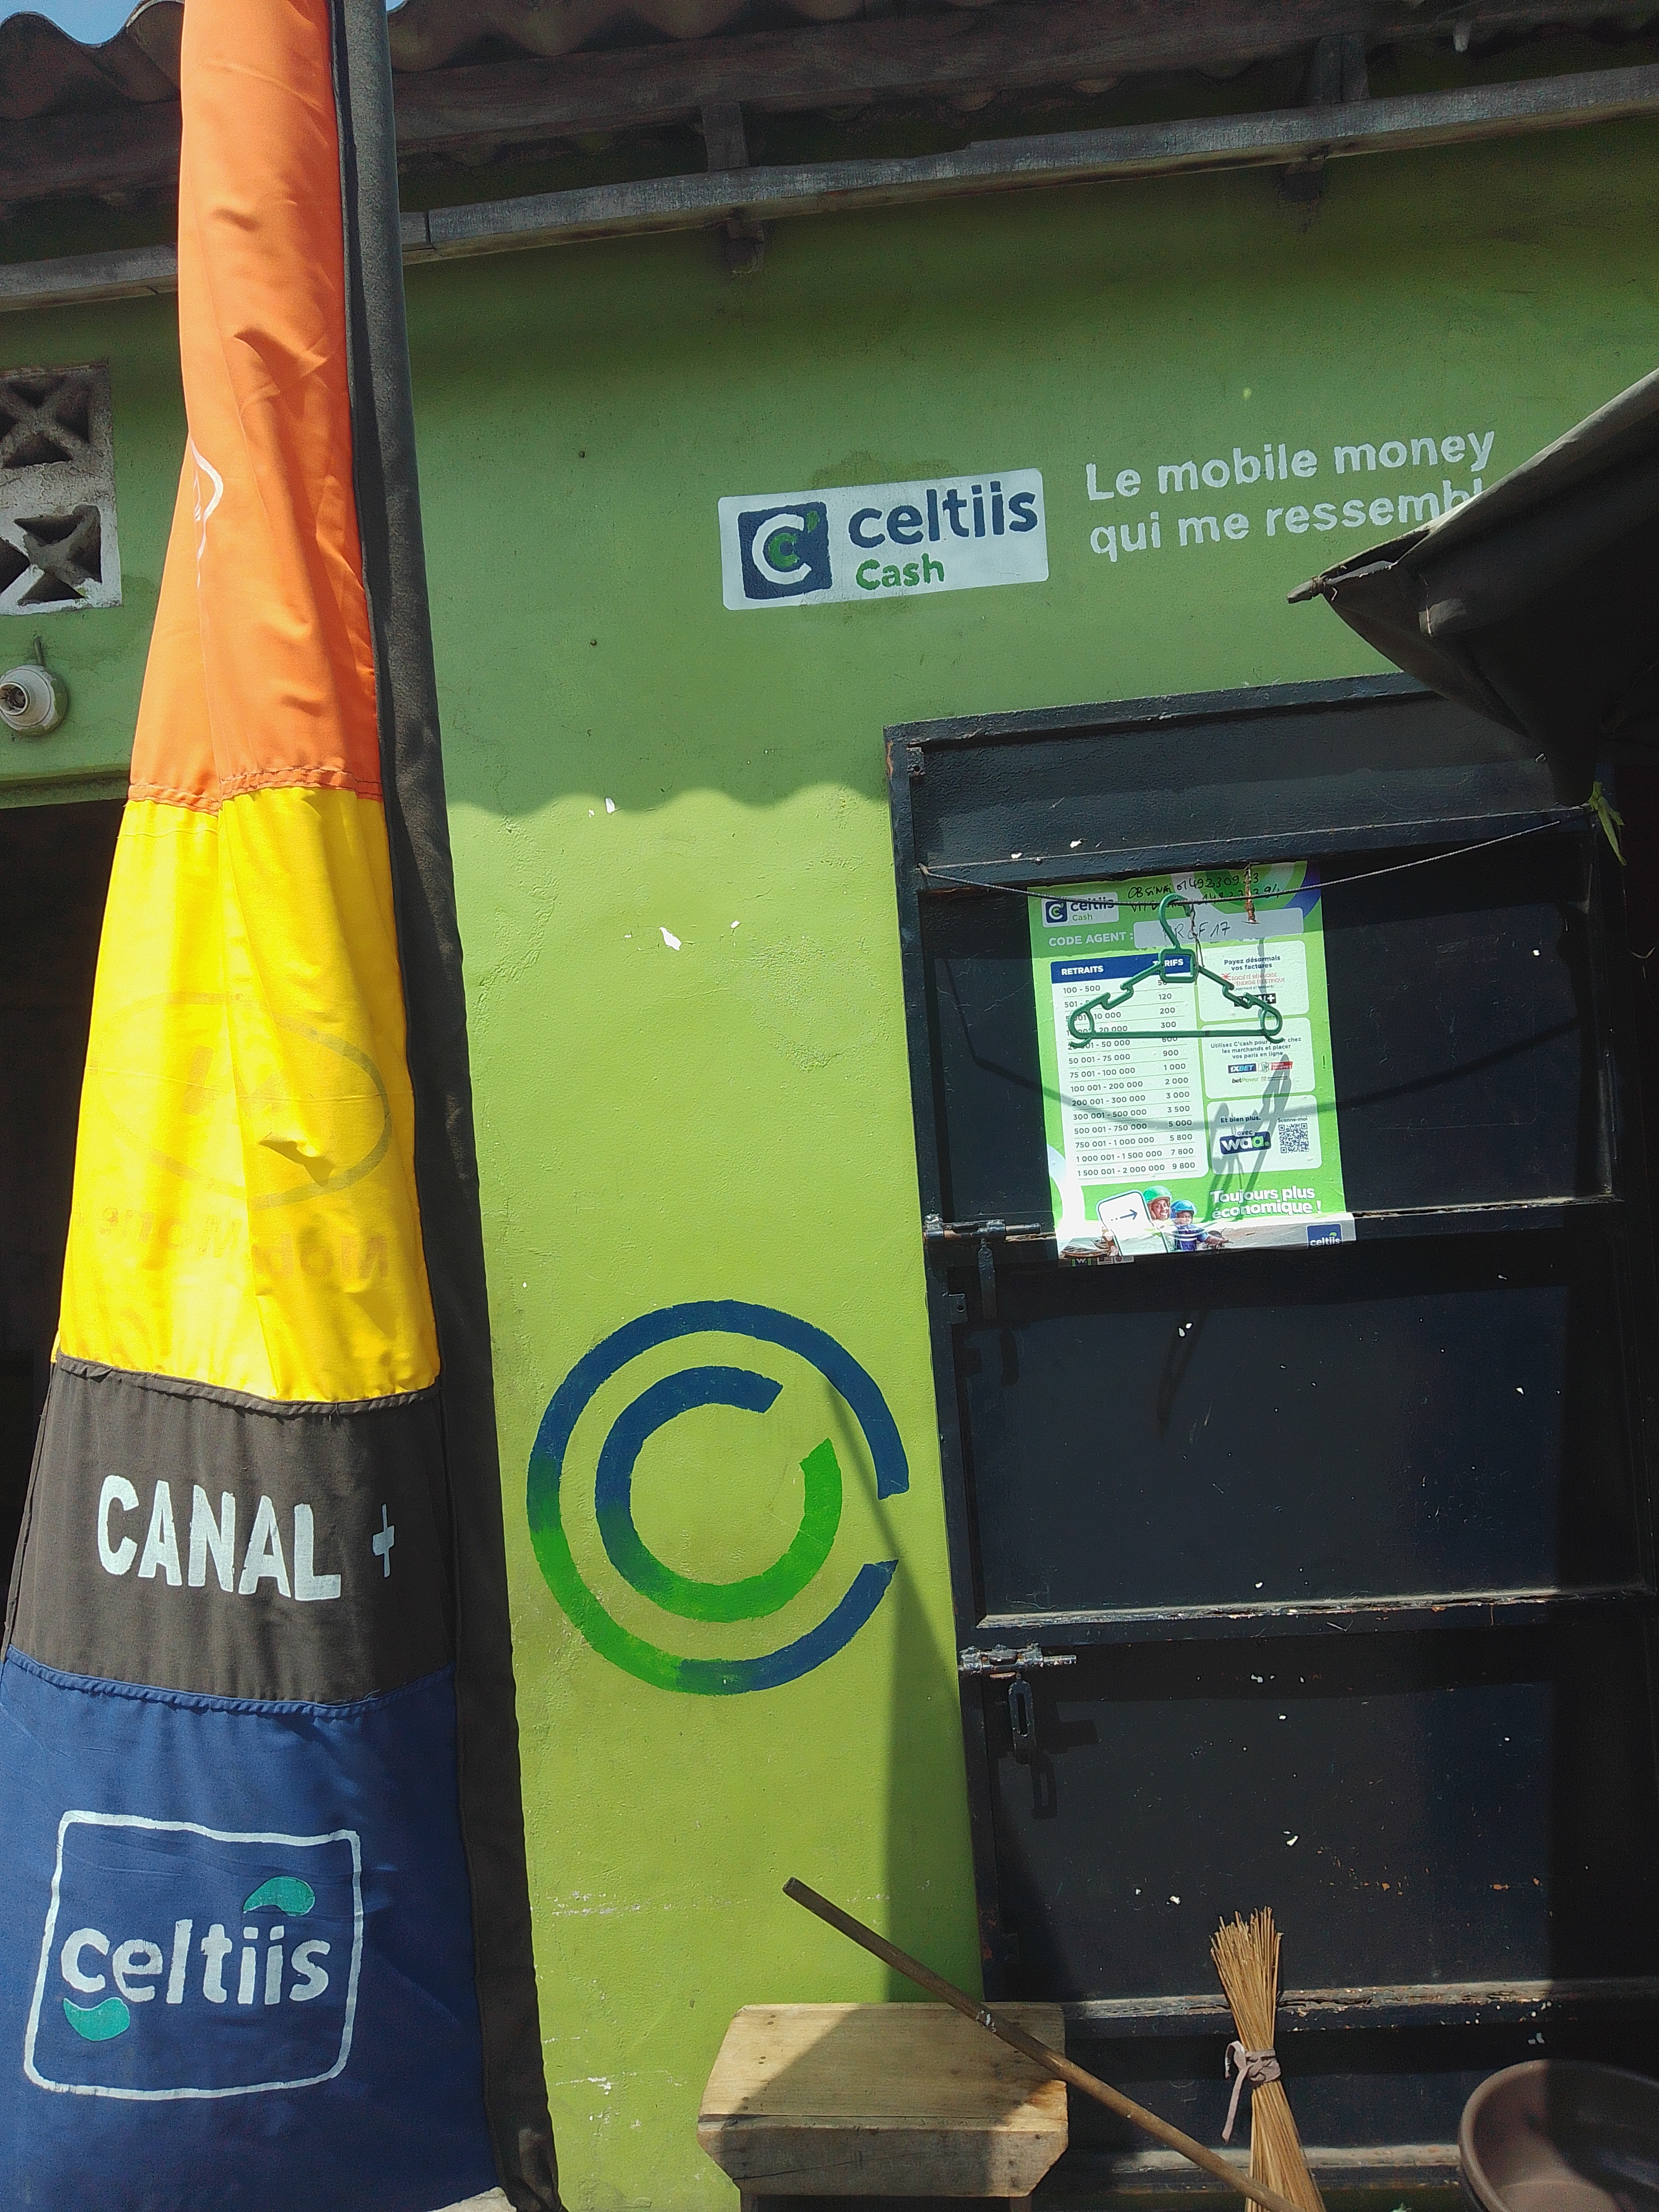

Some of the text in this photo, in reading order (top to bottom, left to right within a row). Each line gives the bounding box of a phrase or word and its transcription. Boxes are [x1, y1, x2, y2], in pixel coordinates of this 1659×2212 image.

[1086, 430, 1495, 500] Le mobile money
[849, 481, 1038, 548] celtiis
[1090, 511, 1161, 563] qui
[1178, 512, 1250, 546] me
[856, 553, 945, 590] Cash
[1049, 935, 1082, 946] CODE
[1085, 931, 1126, 944] AGENT
[1061, 966, 1103, 976] RETRAITS
[1210, 1185, 1315, 1203] Toujours plus
[1212, 1200, 1313, 1219] économique
[1310, 1237, 1340, 1247] celtiis
[97, 1473, 342, 1603] CANAL
[60, 1917, 334, 2005] celtiis
